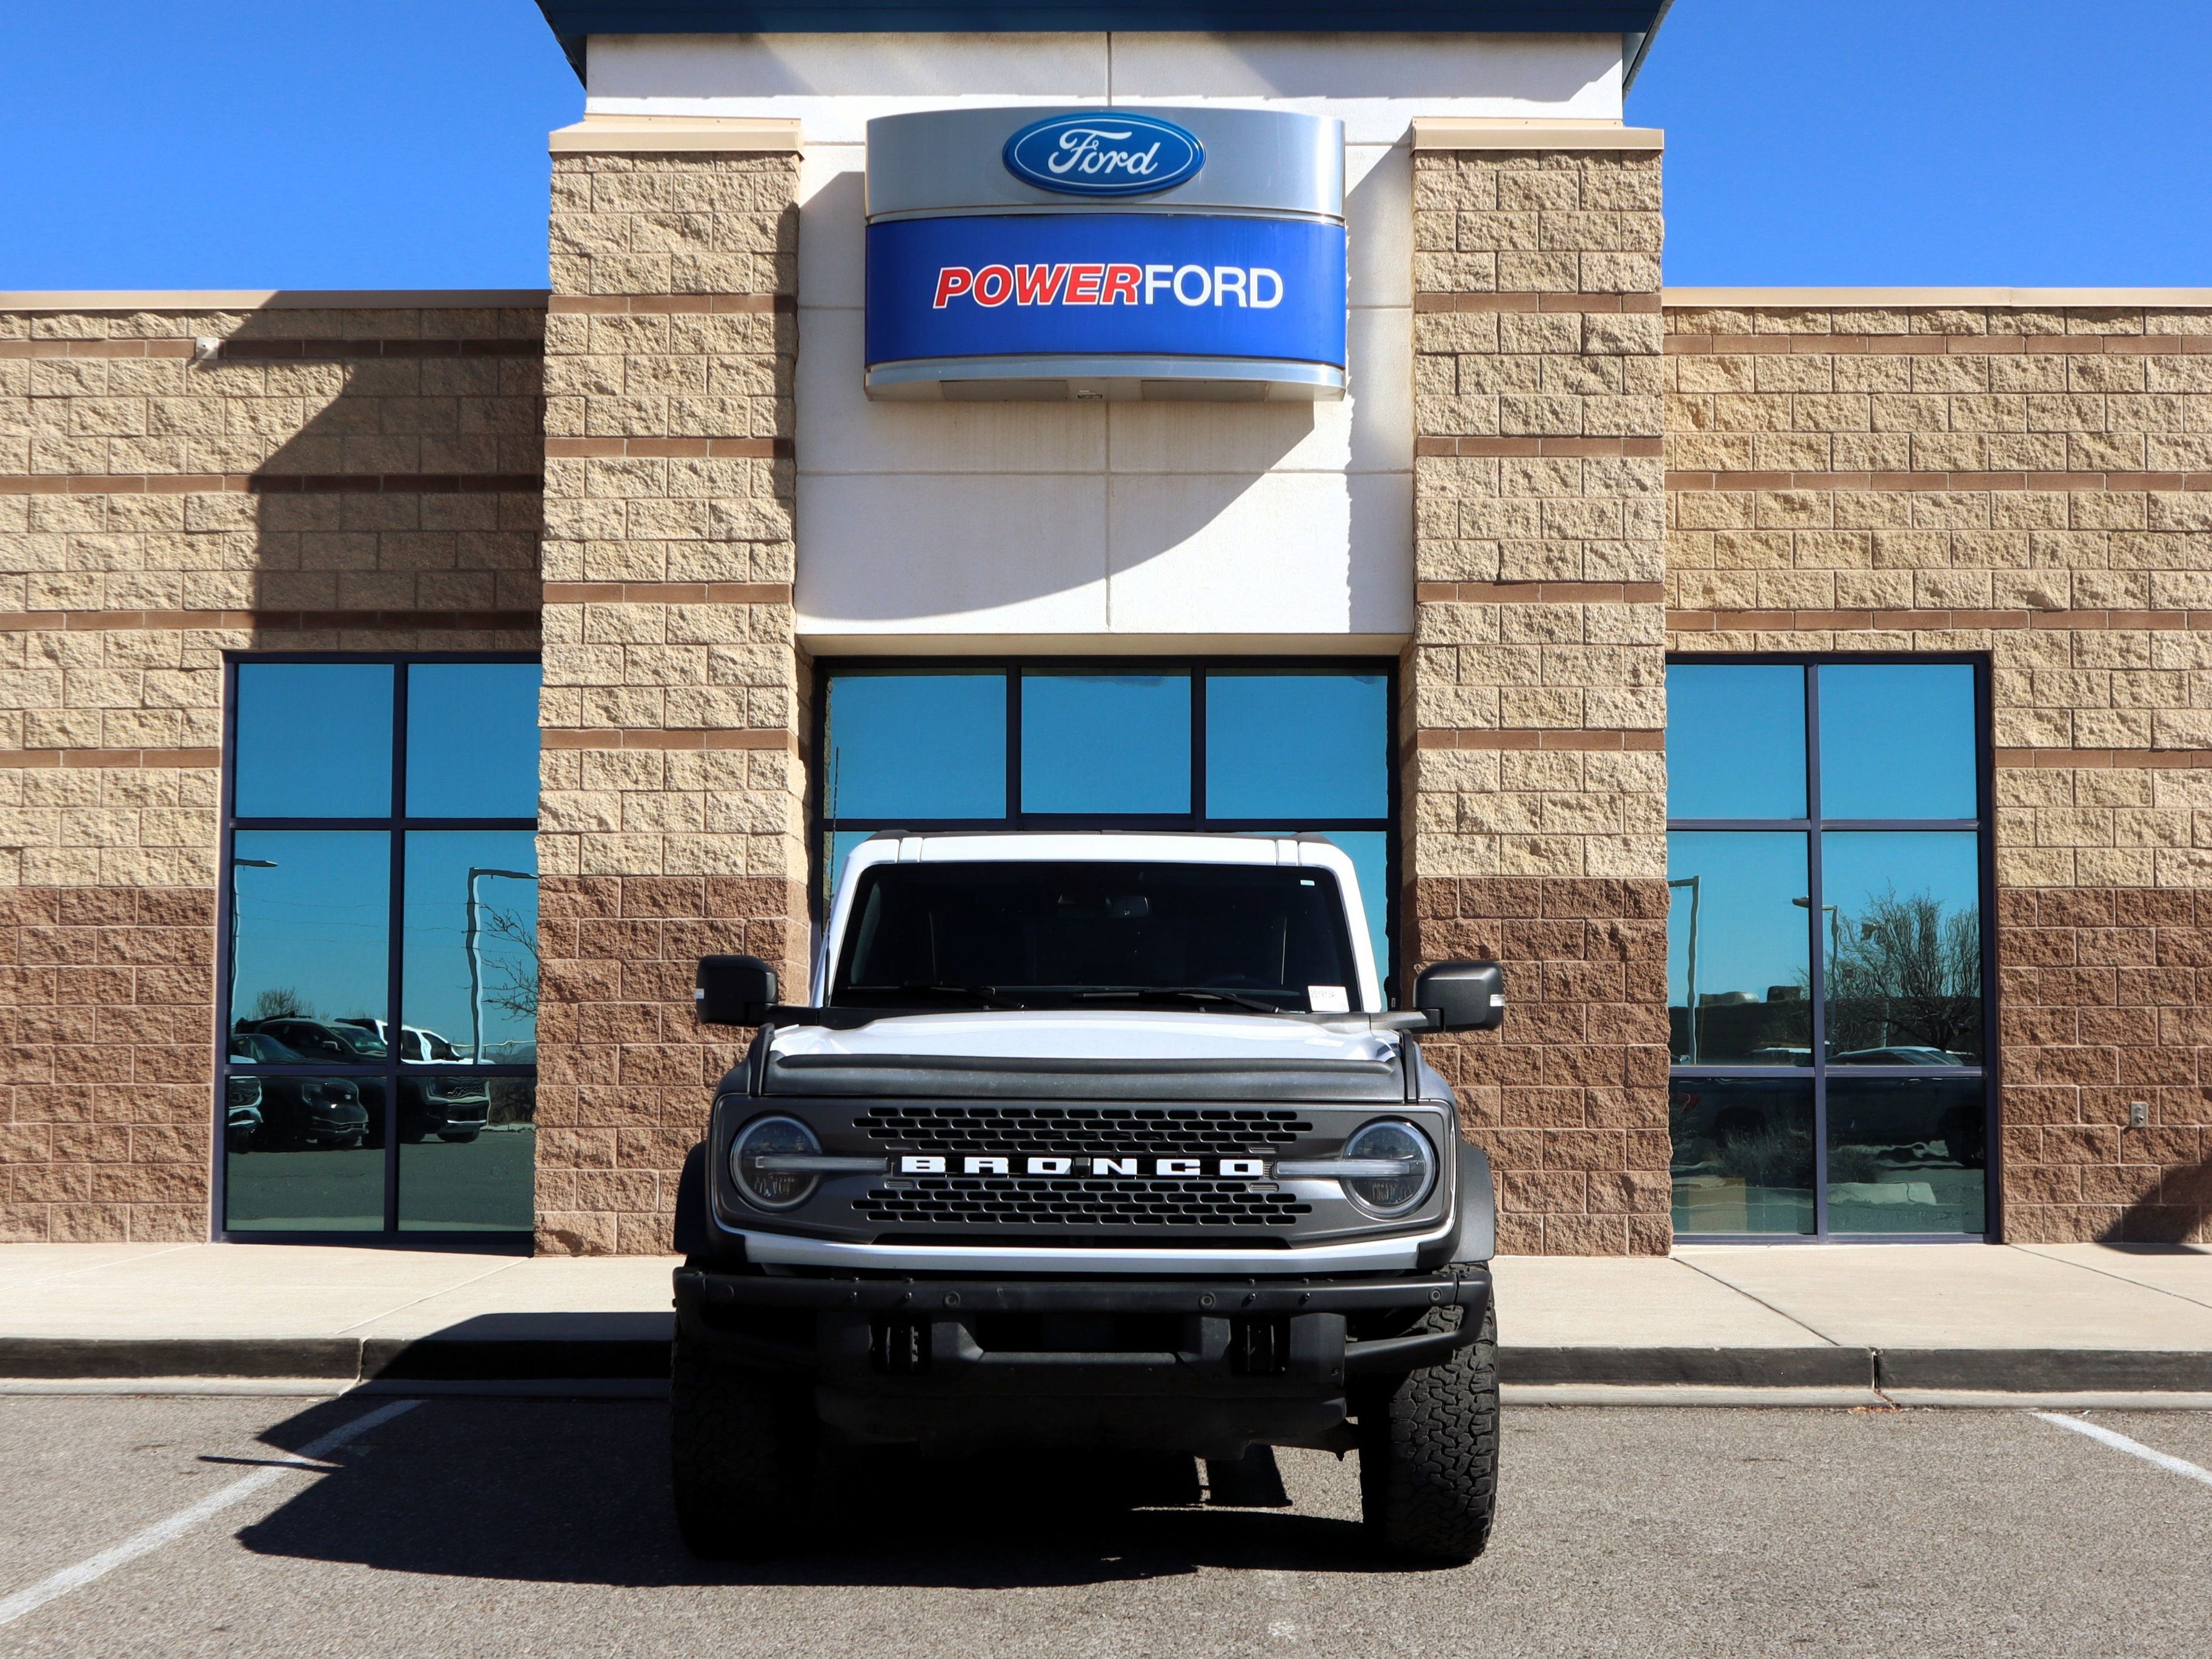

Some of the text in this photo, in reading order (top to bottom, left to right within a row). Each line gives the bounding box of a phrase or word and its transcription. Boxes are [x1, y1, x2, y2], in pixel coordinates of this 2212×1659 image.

[1048, 128, 1161, 175] Ford
[933, 264, 1284, 309] POWERFORD
[902, 1156, 1263, 1176] BRONCO
